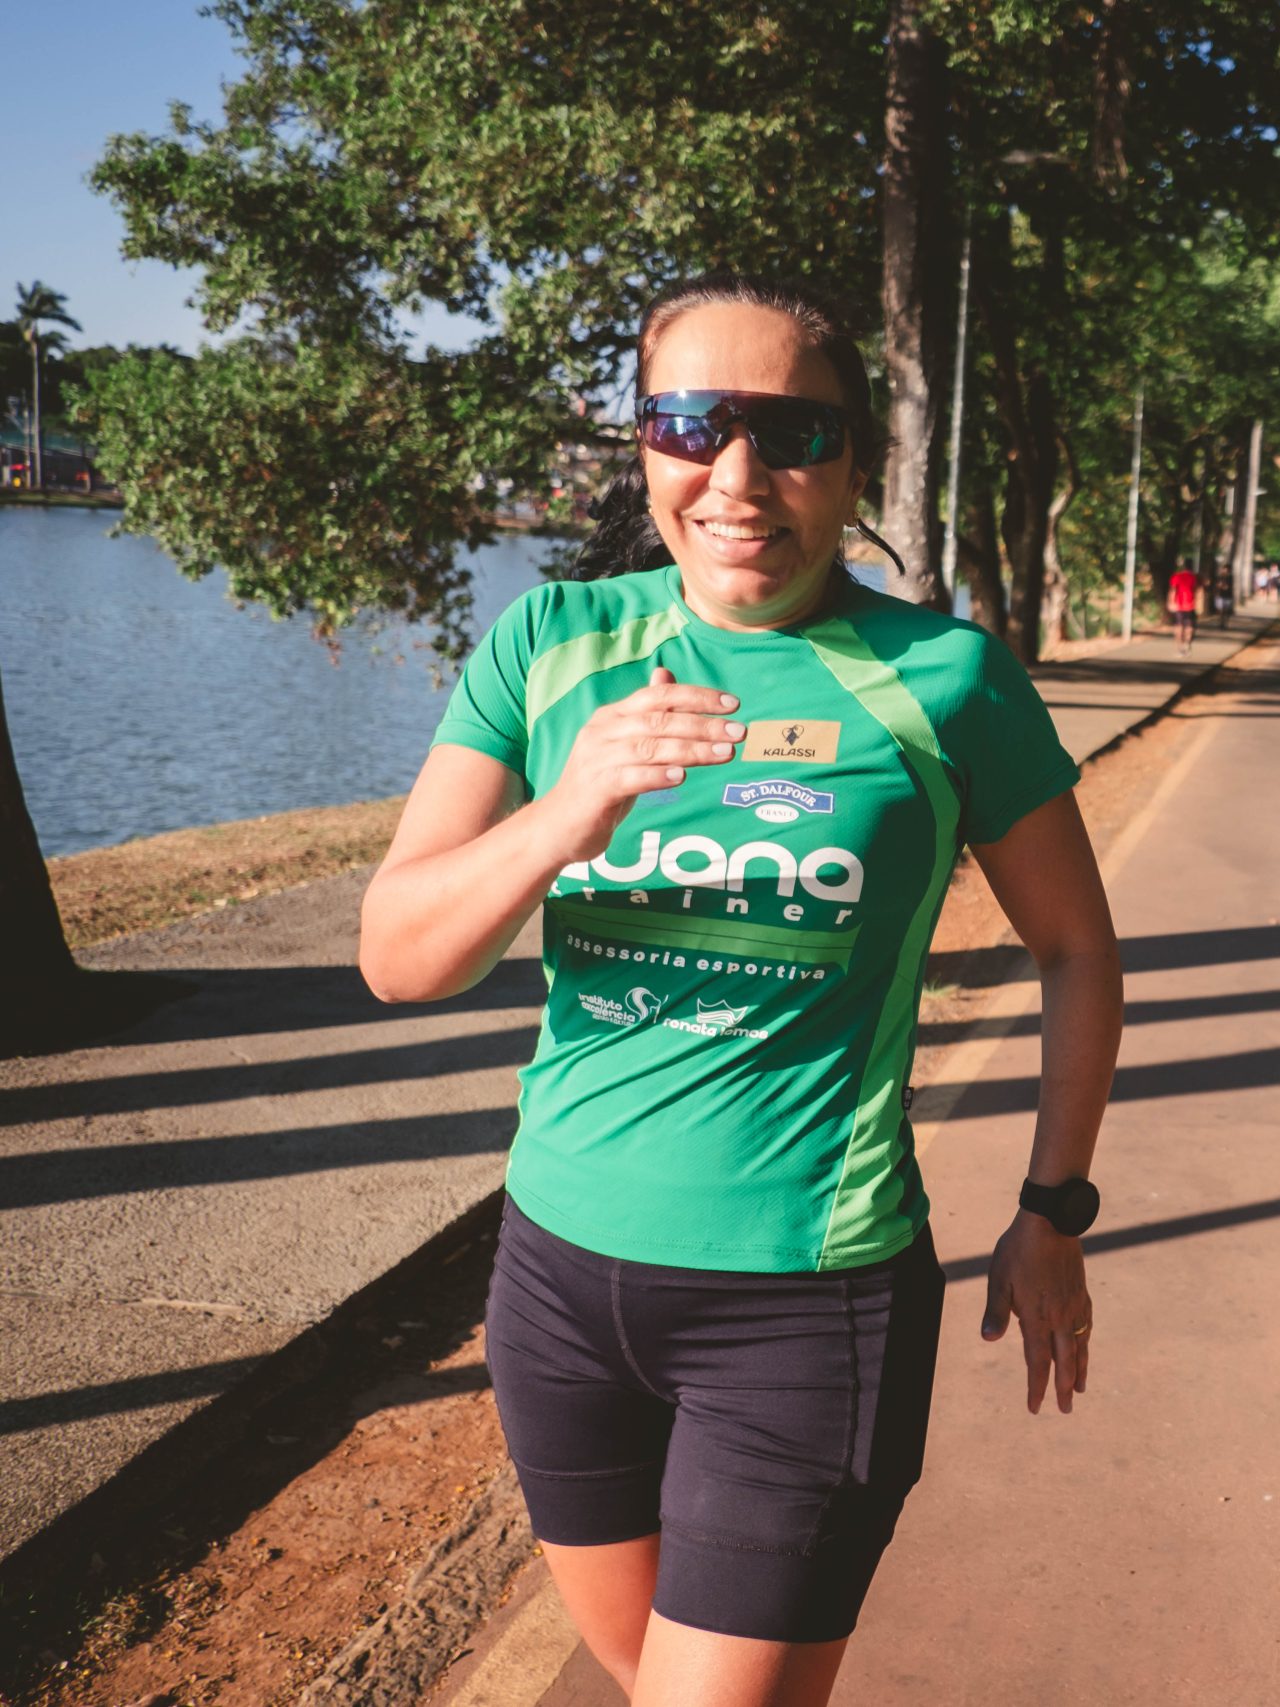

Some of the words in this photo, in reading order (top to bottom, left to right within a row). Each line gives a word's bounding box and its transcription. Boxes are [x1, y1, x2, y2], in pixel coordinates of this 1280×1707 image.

[763, 748, 816, 758] KALASSI
[740, 788, 759, 802] ST.
[760, 785, 817, 807] DALFOUR
[761, 810, 793, 818] FRANCE
[567, 934, 686, 968] assessoria
[696, 957, 825, 981] esportiva
